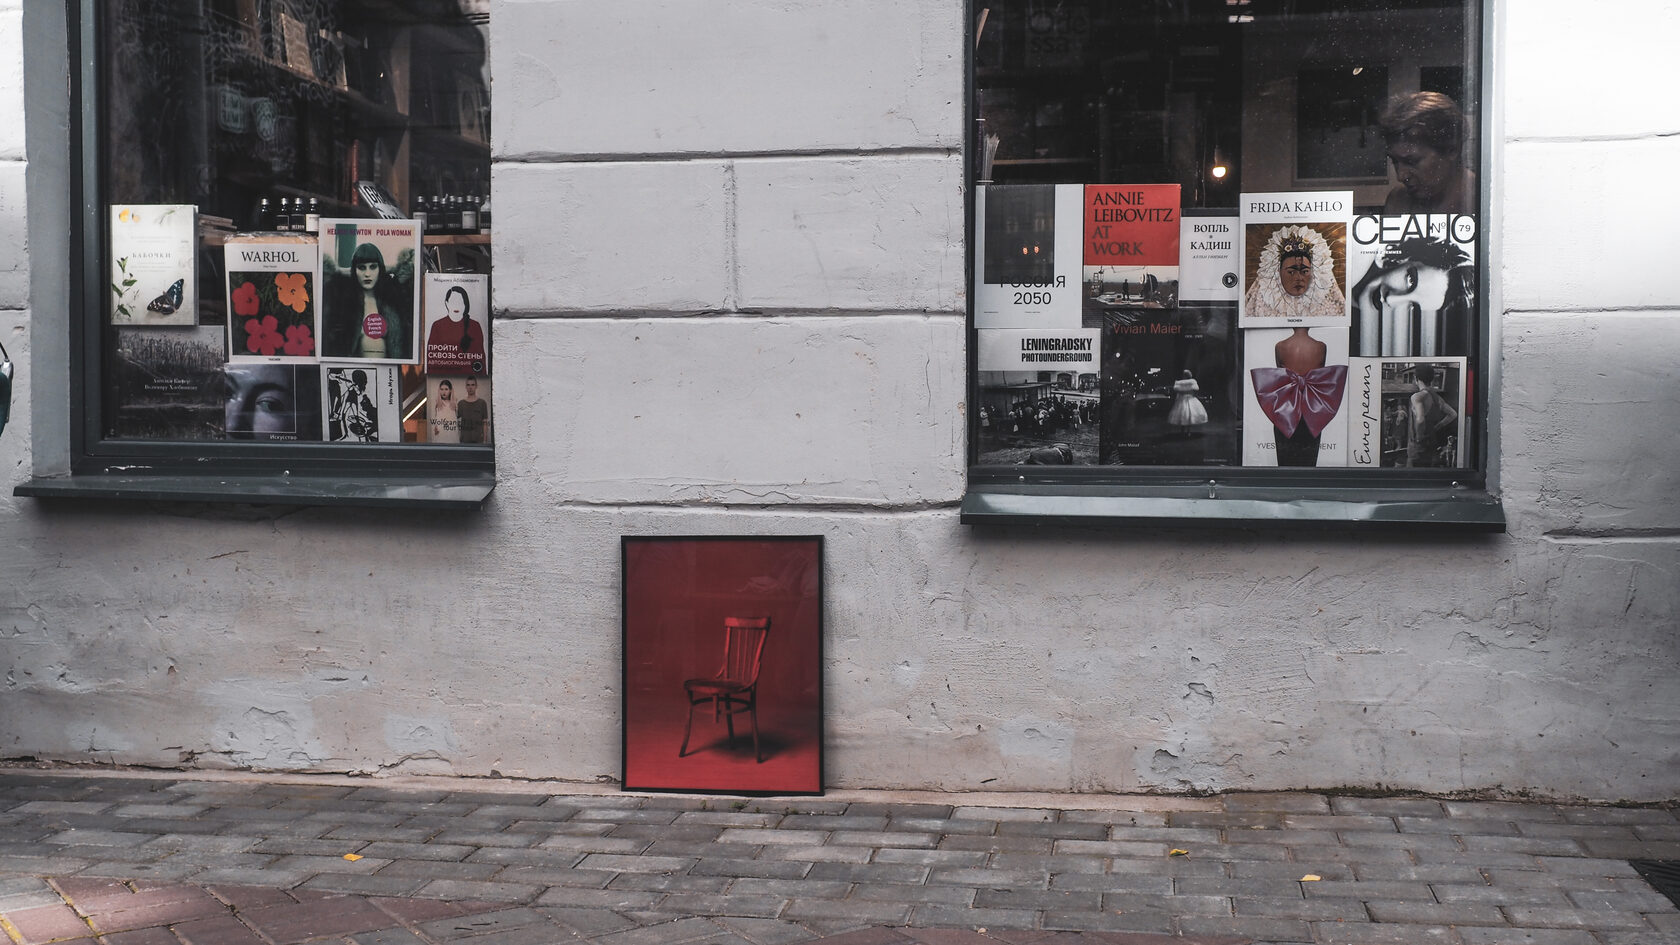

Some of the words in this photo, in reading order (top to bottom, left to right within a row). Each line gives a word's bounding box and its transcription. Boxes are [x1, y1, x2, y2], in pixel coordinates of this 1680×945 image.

[1093, 191, 1144, 206] ANNIE
[1250, 202, 1290, 213] FRIDA
[1294, 201, 1343, 212] KAHLO
[1094, 208, 1173, 222] LEIBOVITZ
[391, 229, 412, 237] WOMAN
[1092, 225, 1112, 239] AT
[1193, 224, 1229, 233] ВОПЛЬ
[1458, 224, 1471, 232] 79
[1092, 241, 1144, 256] WORK
[1190, 241, 1231, 251] КАДИШ
[241, 251, 299, 263] WARHOL
[1013, 291, 1052, 305] 2050
[1113, 322, 1146, 334] Vivian
[1150, 322, 1182, 334] Maier
[1021, 338, 1092, 351] LENINGRADSKY
[1021, 353, 1092, 362] PHOTOUNDERGROUND
[1354, 364, 1378, 465] Europeans
